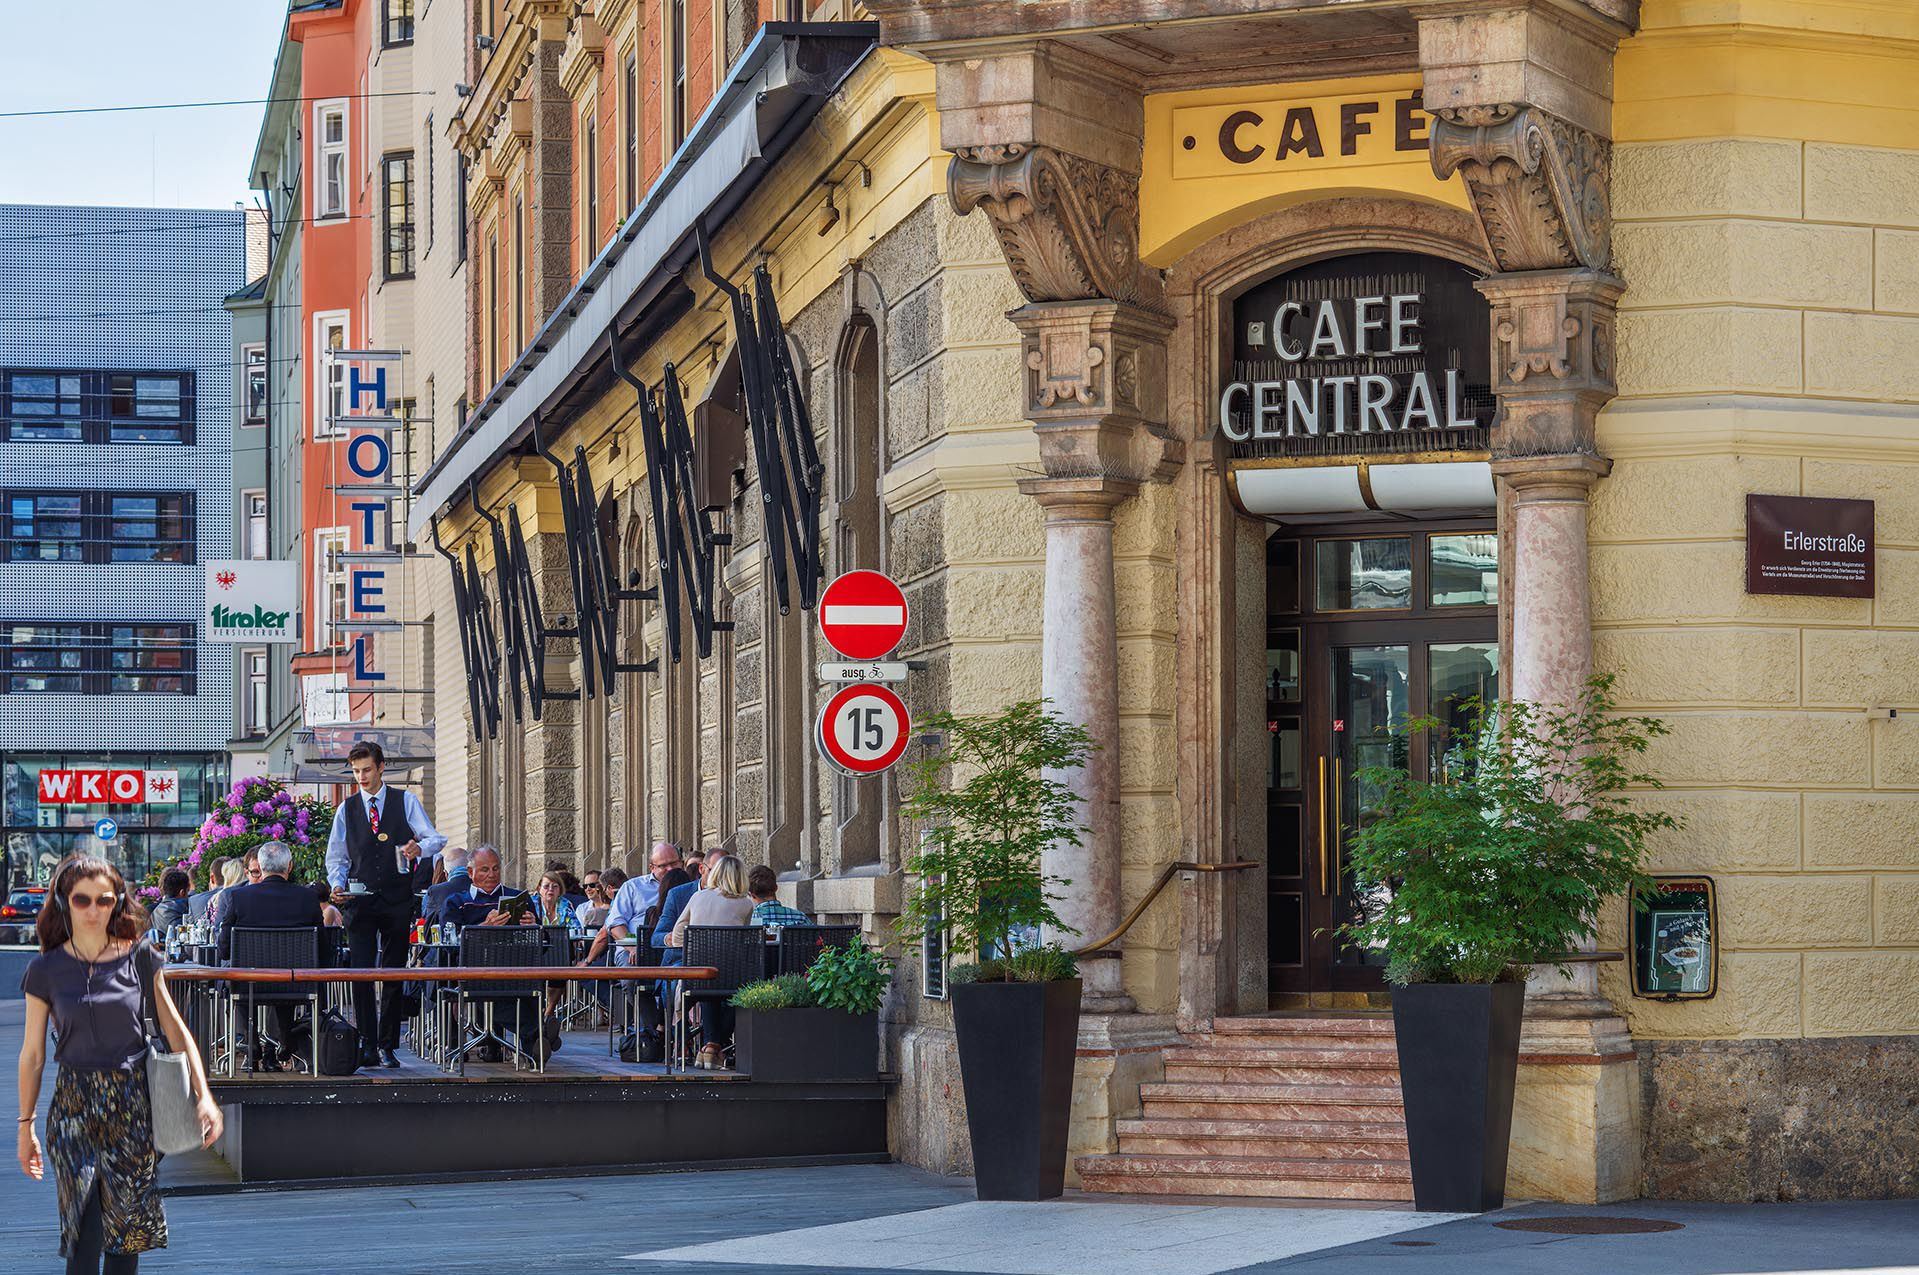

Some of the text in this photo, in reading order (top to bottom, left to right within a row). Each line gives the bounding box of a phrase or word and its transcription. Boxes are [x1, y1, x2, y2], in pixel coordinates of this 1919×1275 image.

[1272, 294, 1424, 361] CAFE
[1220, 368, 1478, 442] CENTRAL
[347, 367, 391, 681] HOTEL
[1784, 530, 1866, 553] Erlerstraße
[211, 603, 290, 628] tiroler
[213, 629, 287, 637] VERSICHERUNG
[841, 667, 867, 681] ausg.
[847, 707, 884, 751] 15
[41, 773, 139, 799] WKO
